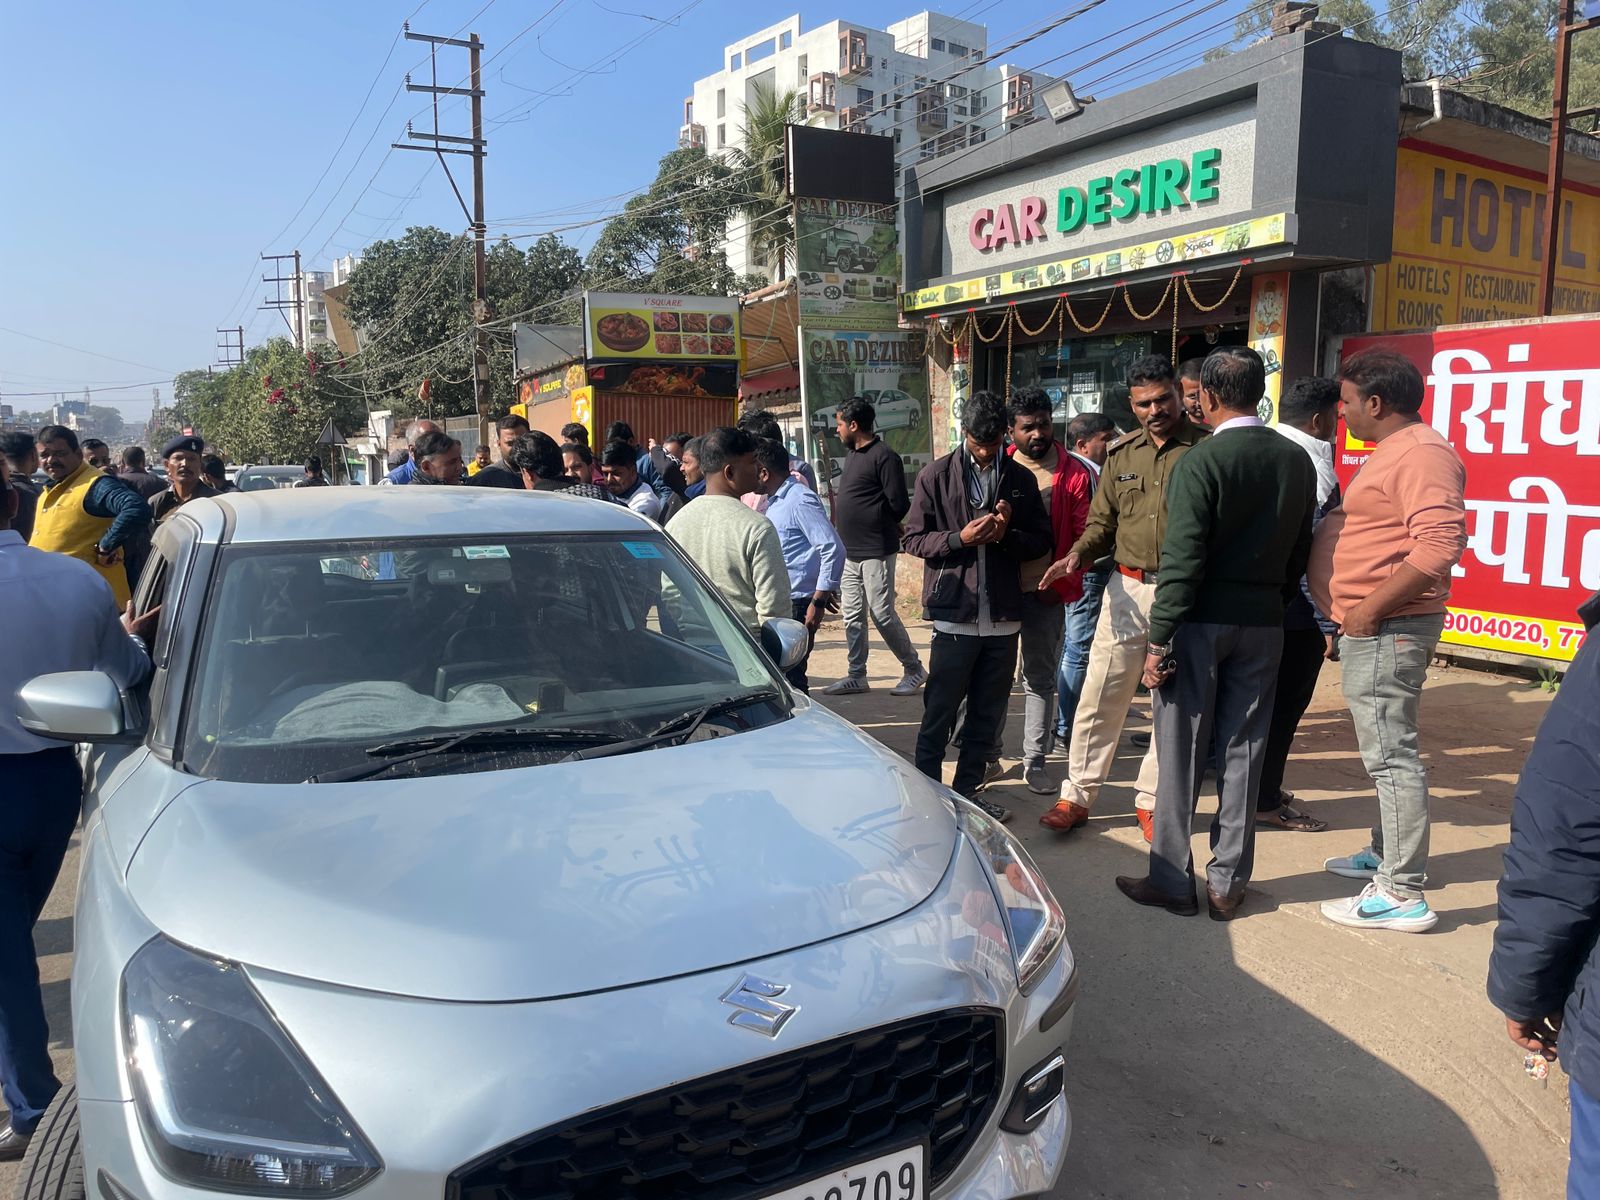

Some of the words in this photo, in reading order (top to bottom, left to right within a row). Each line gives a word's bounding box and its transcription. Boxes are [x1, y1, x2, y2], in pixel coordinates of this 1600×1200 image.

[797, 197, 831, 215] CAR
[969, 196, 1047, 250] CAR
[1057, 148, 1221, 233] DESIRE
[1397, 264, 1450, 296] HOTELS
[1465, 273, 1536, 306] RESTAURANT
[651, 298, 682, 306] SQUARE
[1397, 300, 1443, 327] ROOMS
[810, 339, 850, 363] CAR
[854, 339, 922, 363] DEZIRE
